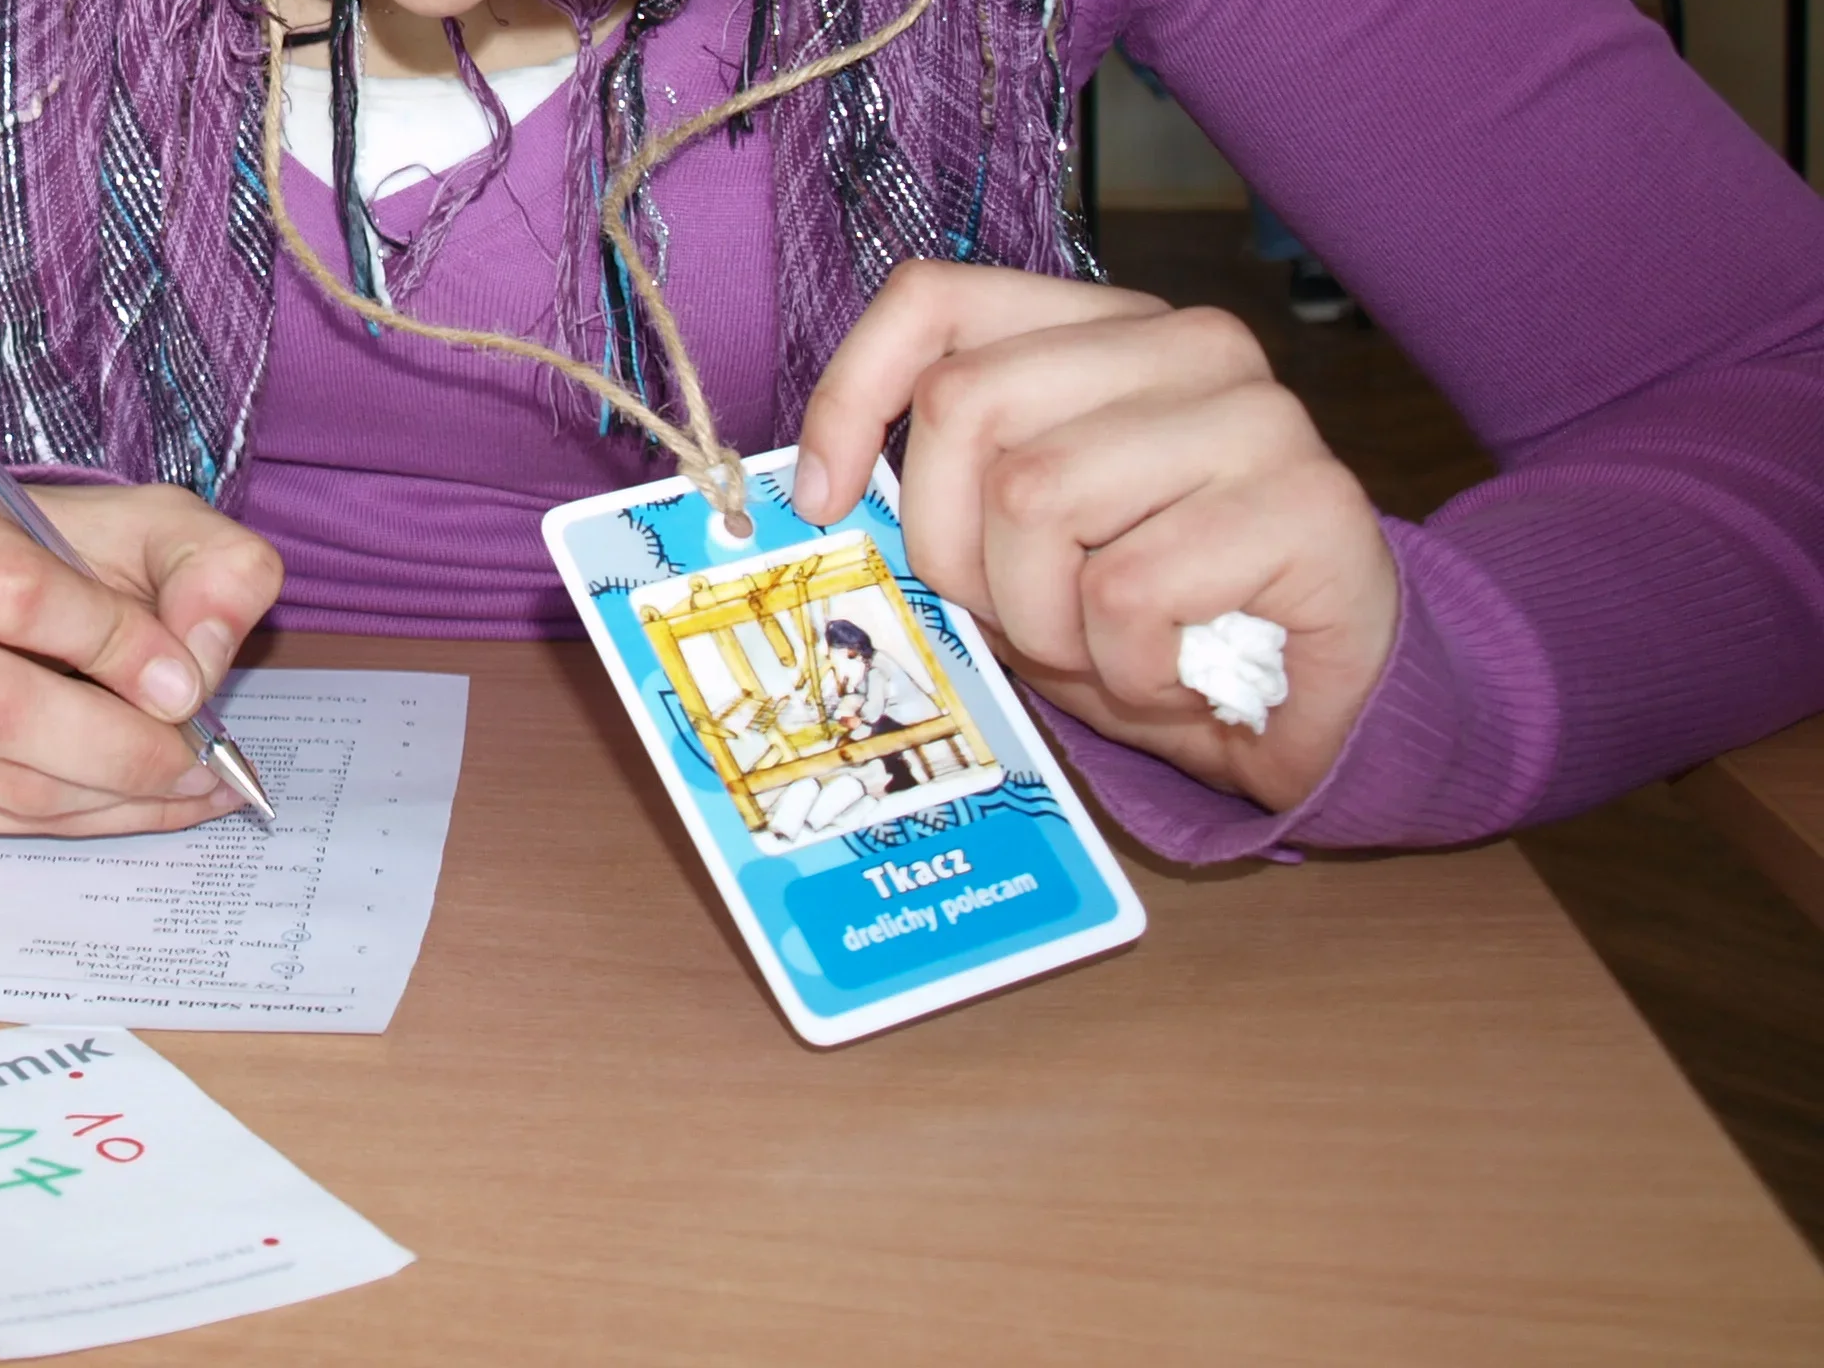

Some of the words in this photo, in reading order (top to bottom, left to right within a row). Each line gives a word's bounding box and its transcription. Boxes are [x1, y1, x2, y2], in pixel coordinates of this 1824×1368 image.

[861, 846, 973, 903] Tkacz
[840, 897, 940, 953] drelichy
[940, 869, 1039, 924] polecam
[240, 940, 299, 951] Tempo
[176, 968, 226, 978] Przed
[188, 979, 248, 988] zasady
[3, 989, 78, 1001] Ankieta
[178, 1000, 242, 1010] Szkoła
